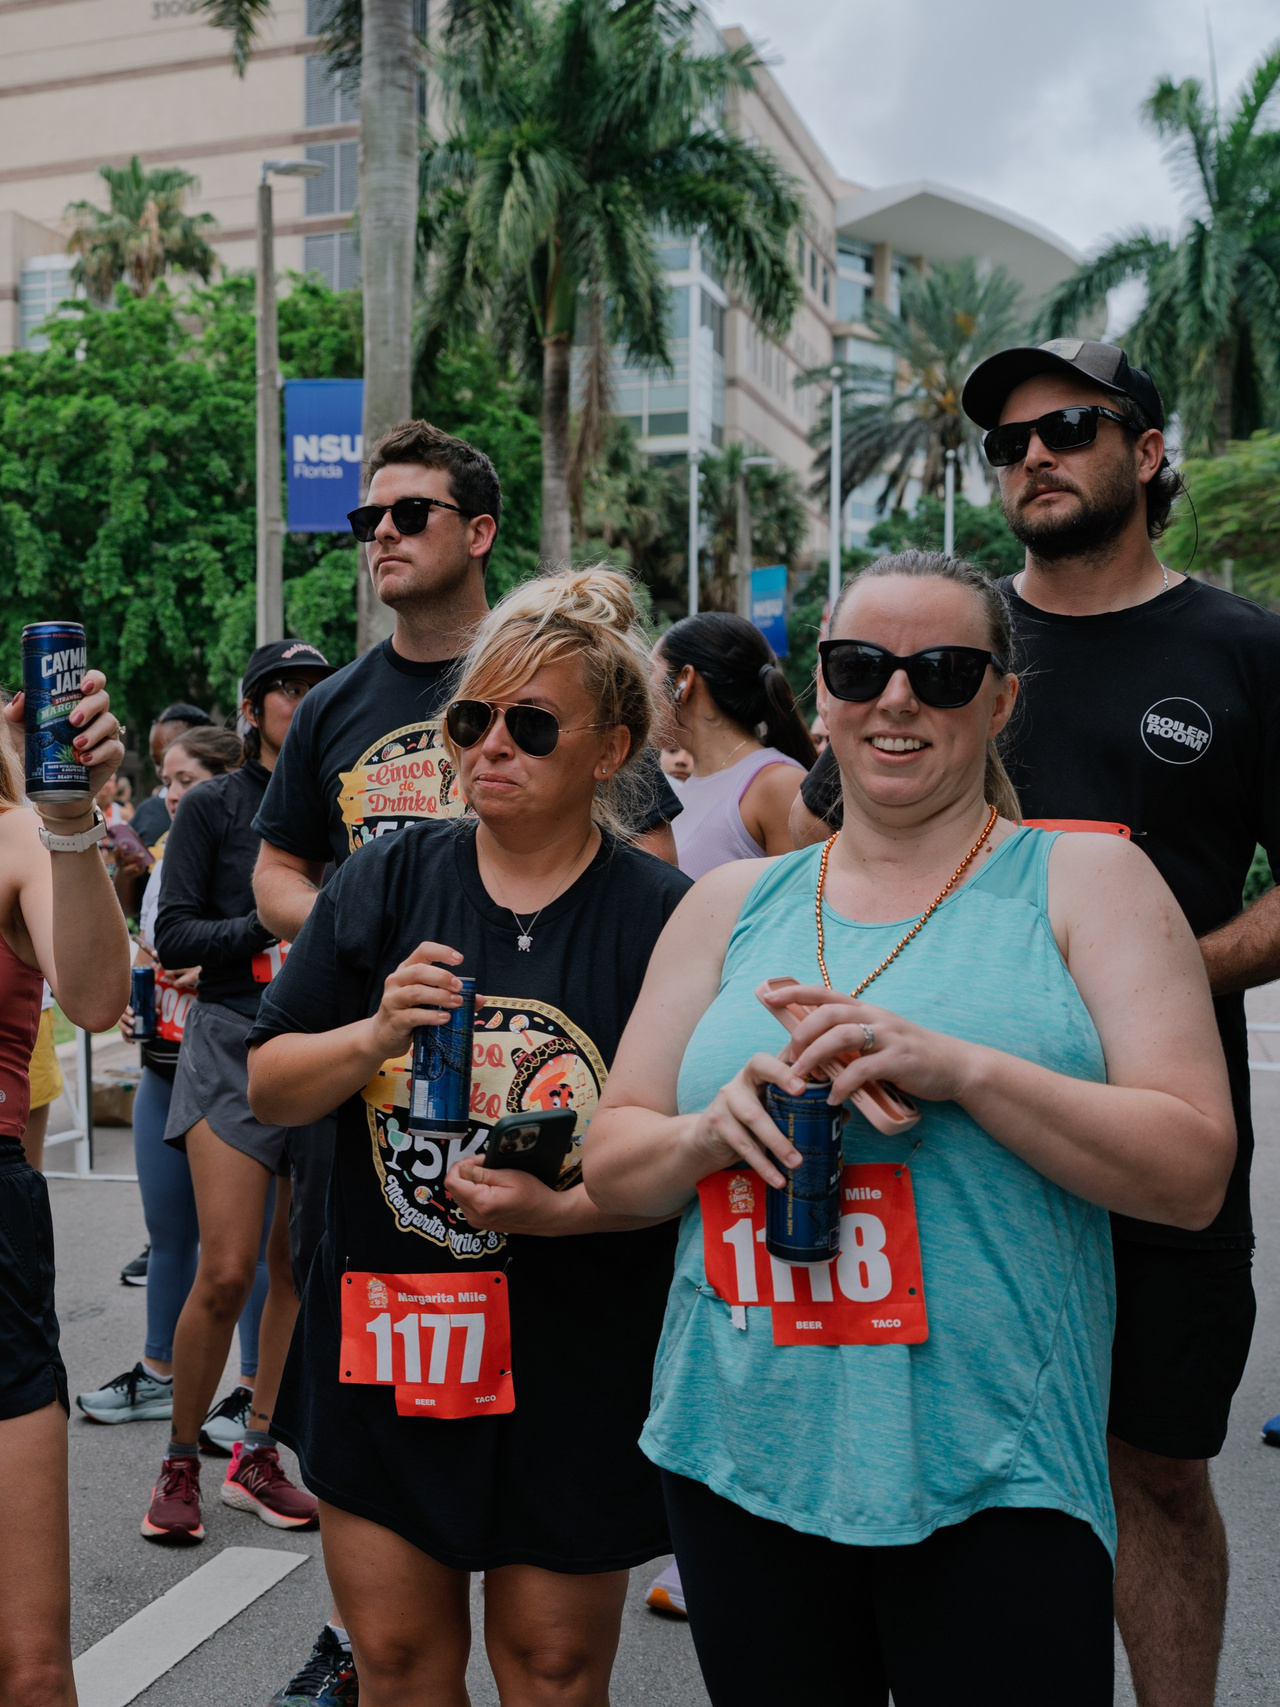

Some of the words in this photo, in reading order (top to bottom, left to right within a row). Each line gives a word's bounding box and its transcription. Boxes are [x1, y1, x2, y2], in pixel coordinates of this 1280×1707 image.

[293, 434, 364, 463] NSU
[293, 463, 343, 479] Florida
[1146, 713, 1209, 743] BOILER
[1146, 723, 1203, 752] ROOM
[367, 759, 437, 786] Cinco
[399, 780, 415, 791] de
[368, 790, 438, 814] Drinko
[845, 1188, 882, 1200] Mile
[385, 1175, 447, 1241] Margarita
[448, 1228, 483, 1254] Mile
[397, 1292, 455, 1305] Margarita
[458, 1292, 487, 1303] Mile
[796, 1321, 823, 1329] BEER
[871, 1318, 902, 1328] TACO
[366, 1312, 486, 1384] 1177
[415, 1398, 436, 1406] BEER
[474, 1395, 497, 1404] TACO
